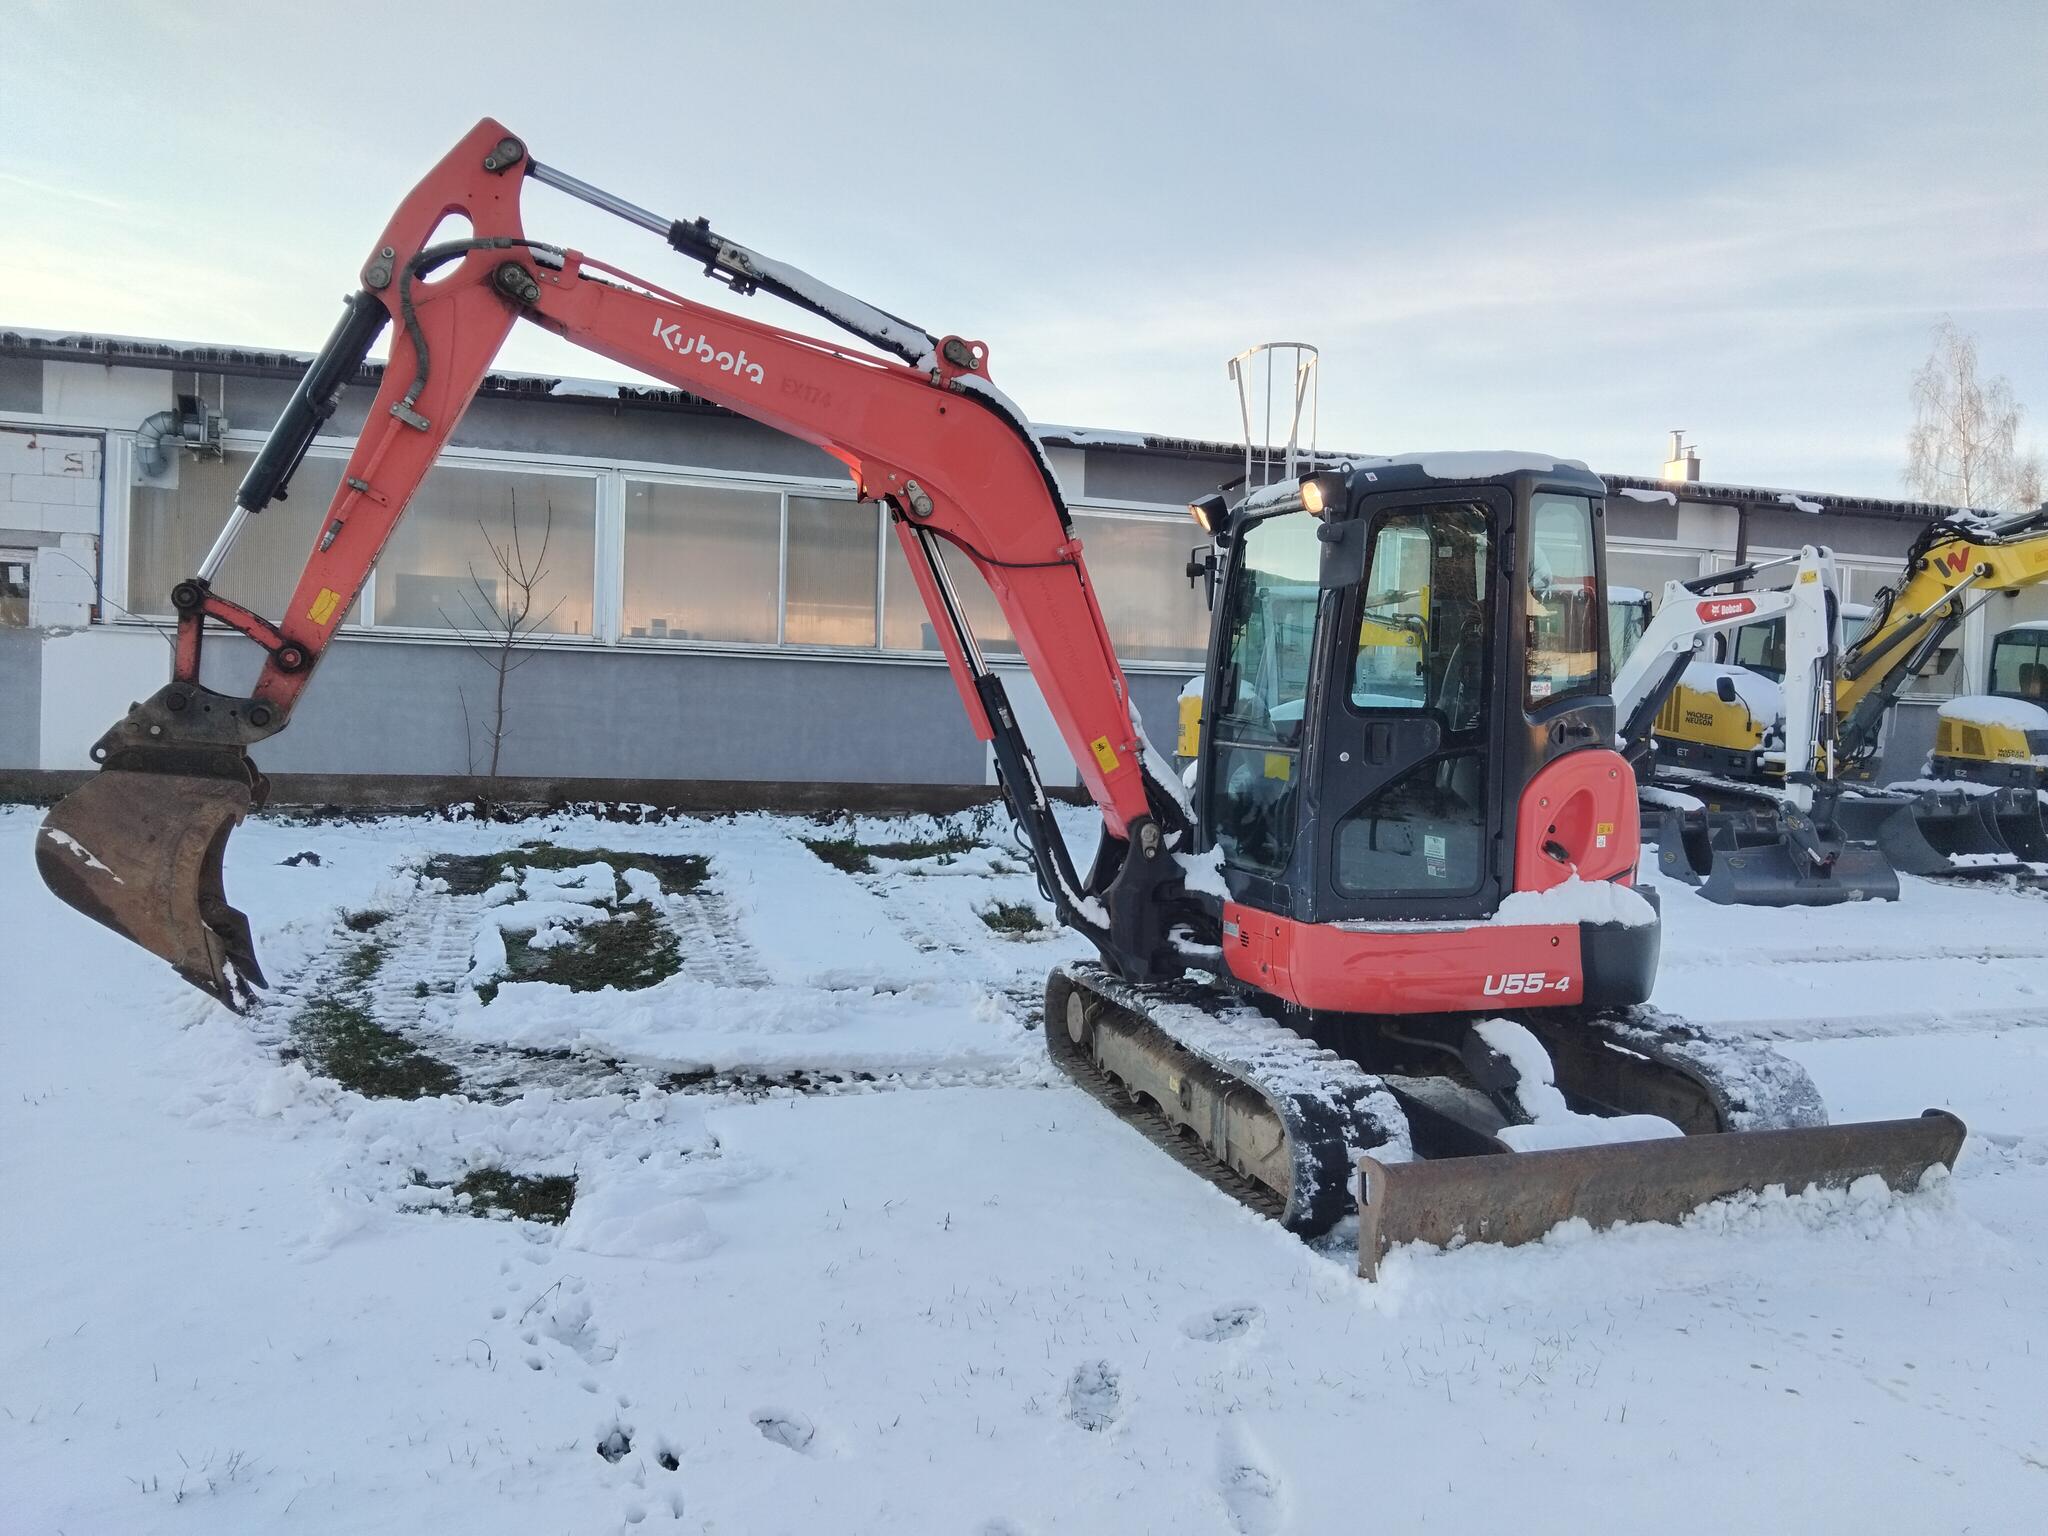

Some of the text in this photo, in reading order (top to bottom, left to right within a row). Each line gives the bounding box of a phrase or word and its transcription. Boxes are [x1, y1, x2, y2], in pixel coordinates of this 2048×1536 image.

[652, 317, 765, 384] Kubota
[1721, 602, 1742, 615] Bobcat
[1686, 710, 1713, 719] WACKER
[1685, 717, 1713, 726] NEUSON
[1677, 748, 1689, 756] ET
[1483, 972, 1570, 996] U55-4
